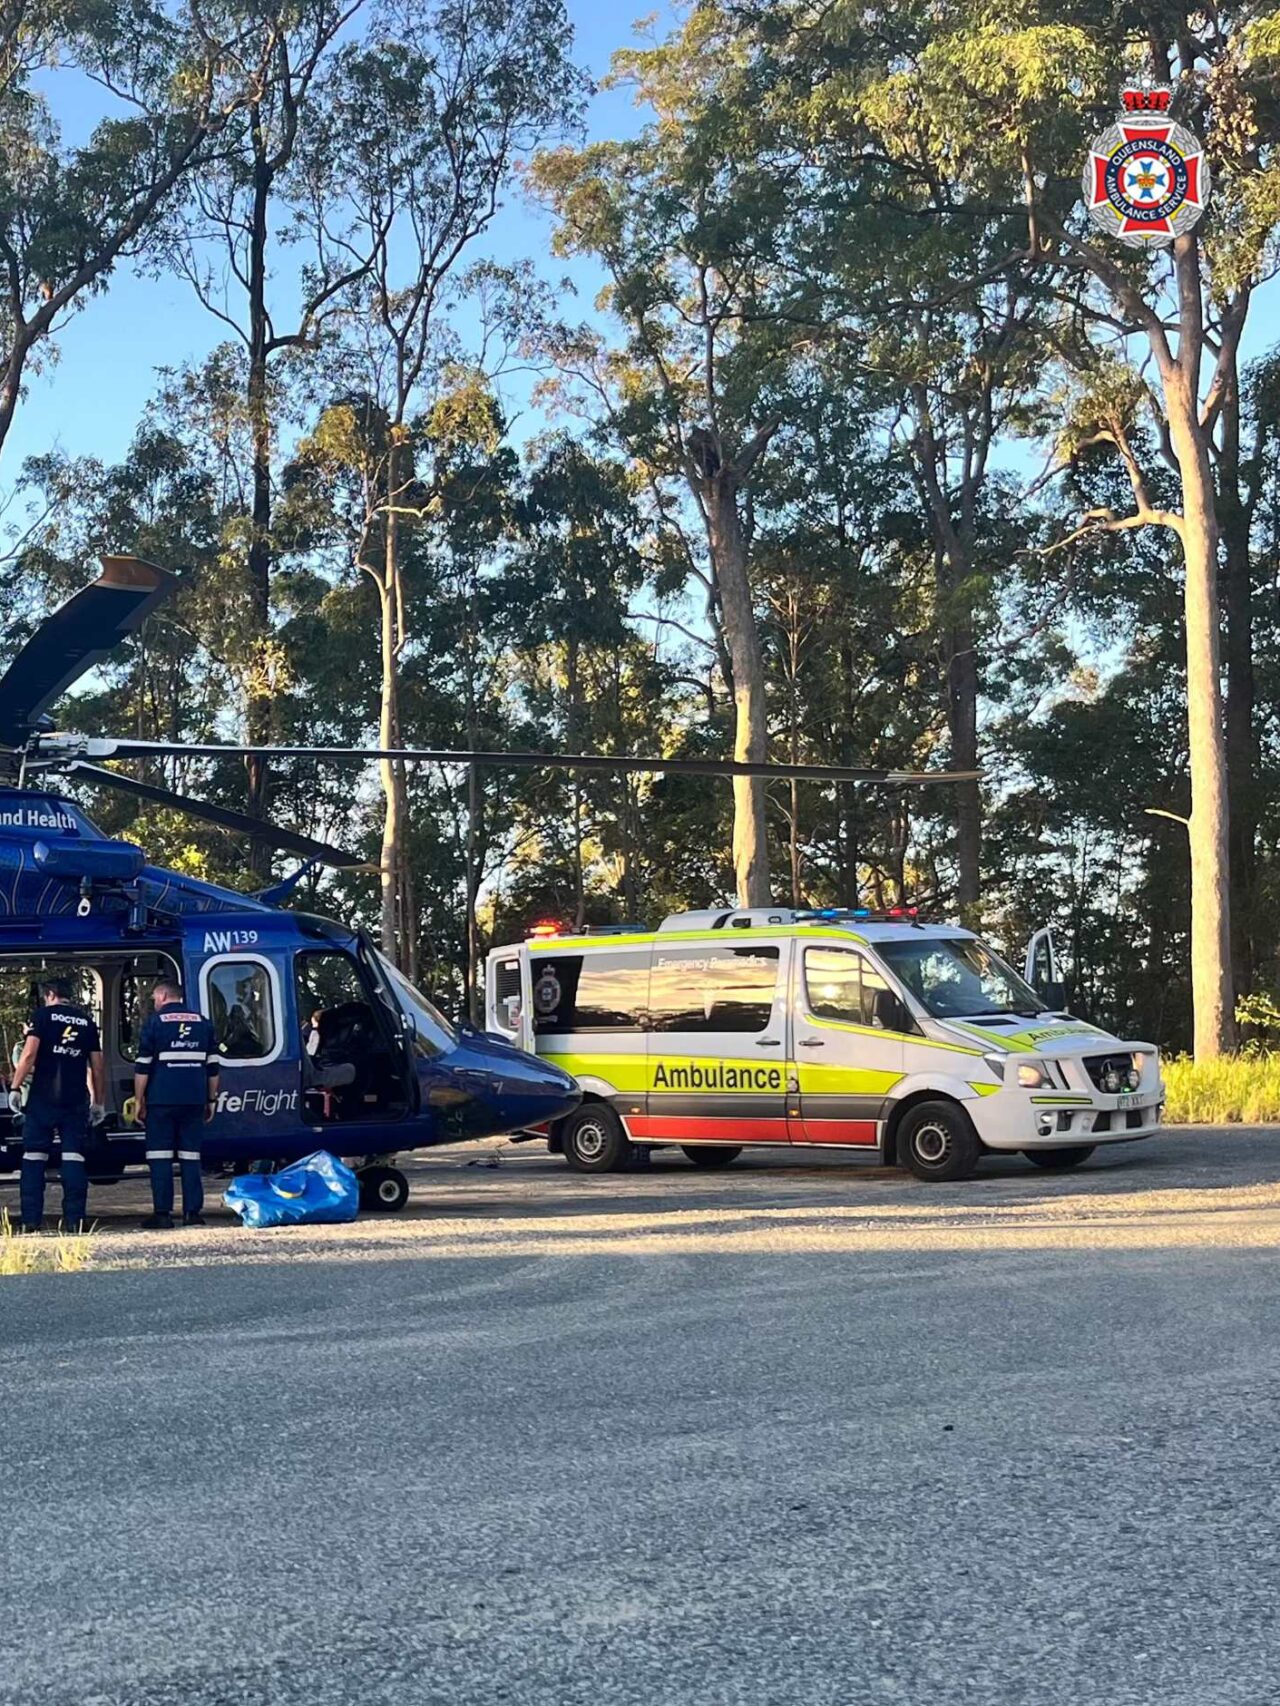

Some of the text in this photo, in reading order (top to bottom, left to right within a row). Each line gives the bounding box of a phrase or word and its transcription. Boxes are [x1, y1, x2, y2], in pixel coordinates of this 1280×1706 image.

[27, 810, 77, 829] Health
[51, 1013, 88, 1026] DOCTOR
[653, 1061, 781, 1089] Ambulance
